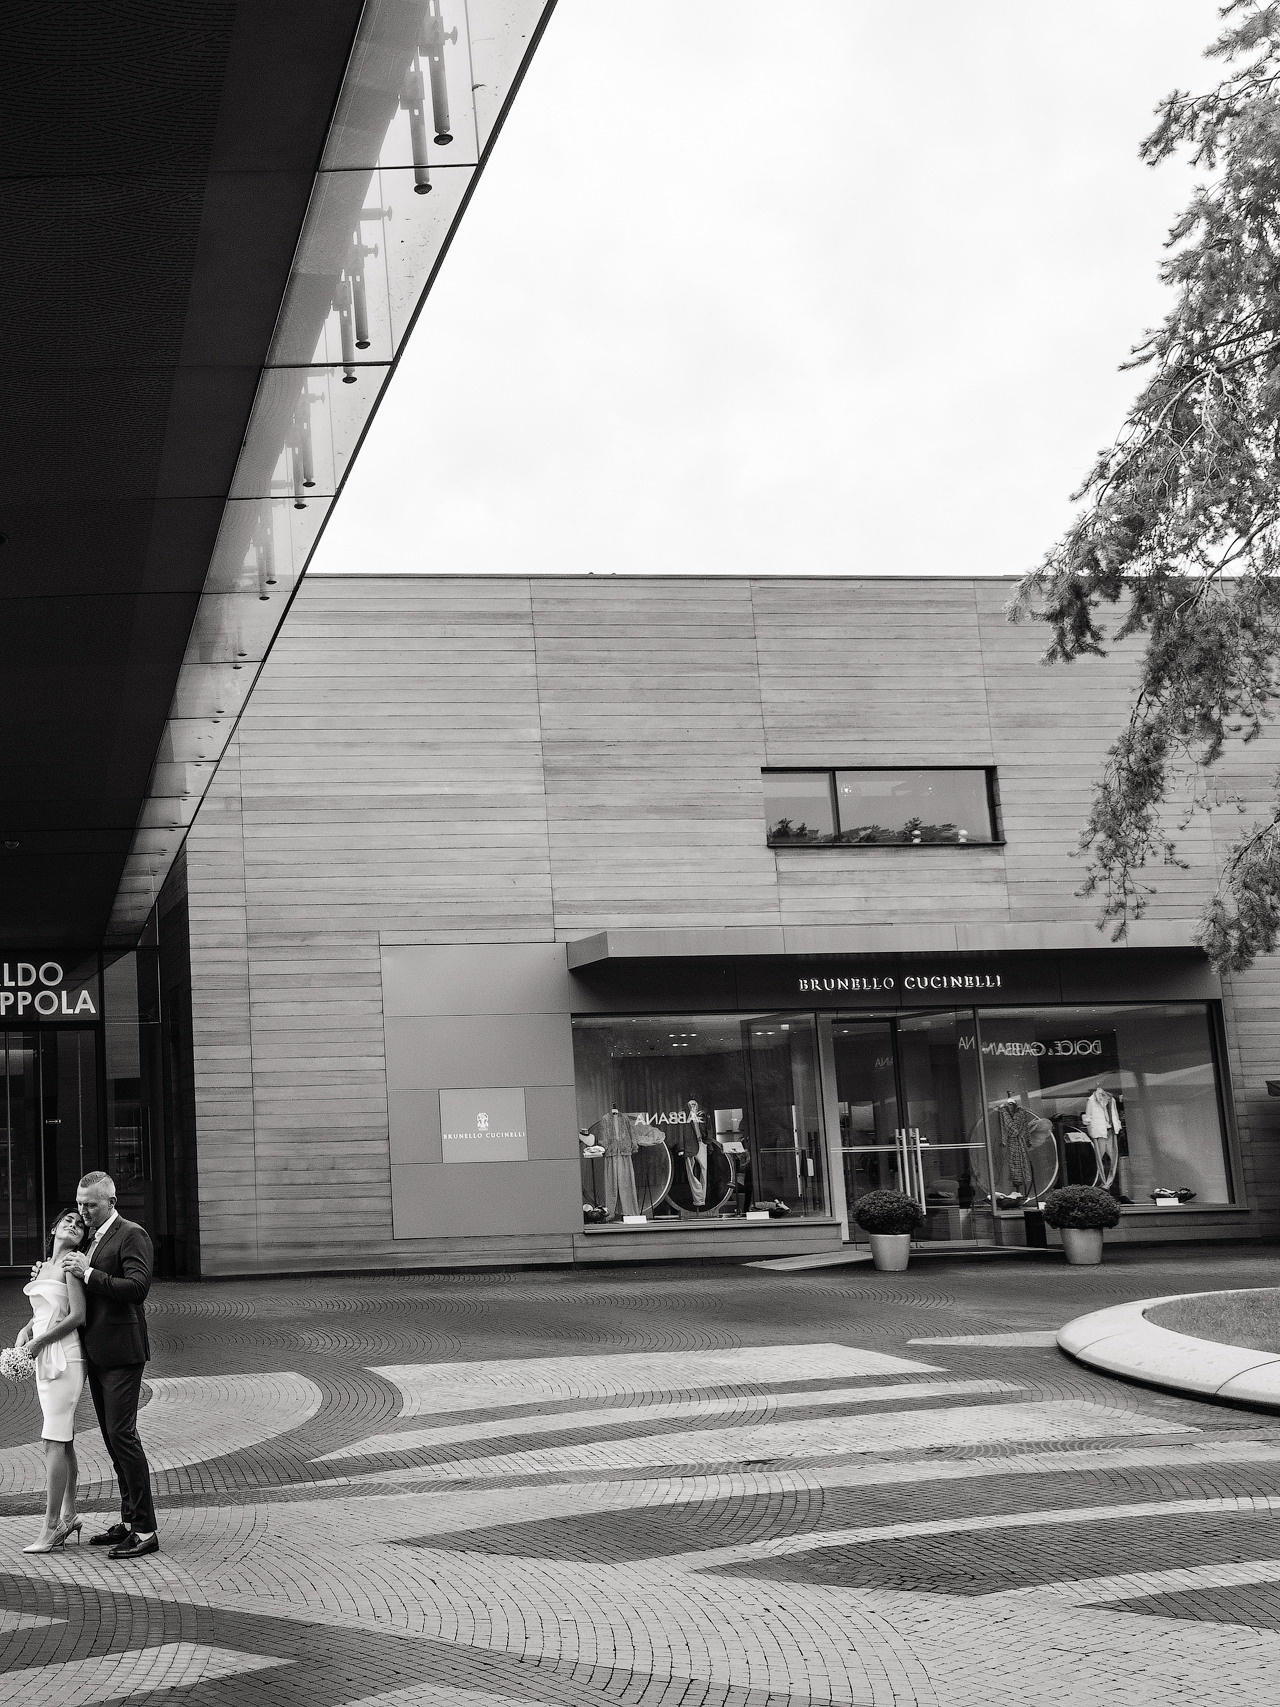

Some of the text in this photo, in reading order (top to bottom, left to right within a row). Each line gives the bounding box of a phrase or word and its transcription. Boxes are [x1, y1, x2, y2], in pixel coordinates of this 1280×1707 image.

[798, 974, 1002, 991] BRUNELLO CUCINELLI
[443, 1131, 526, 1140] BRUNELLO CUCINELLI
